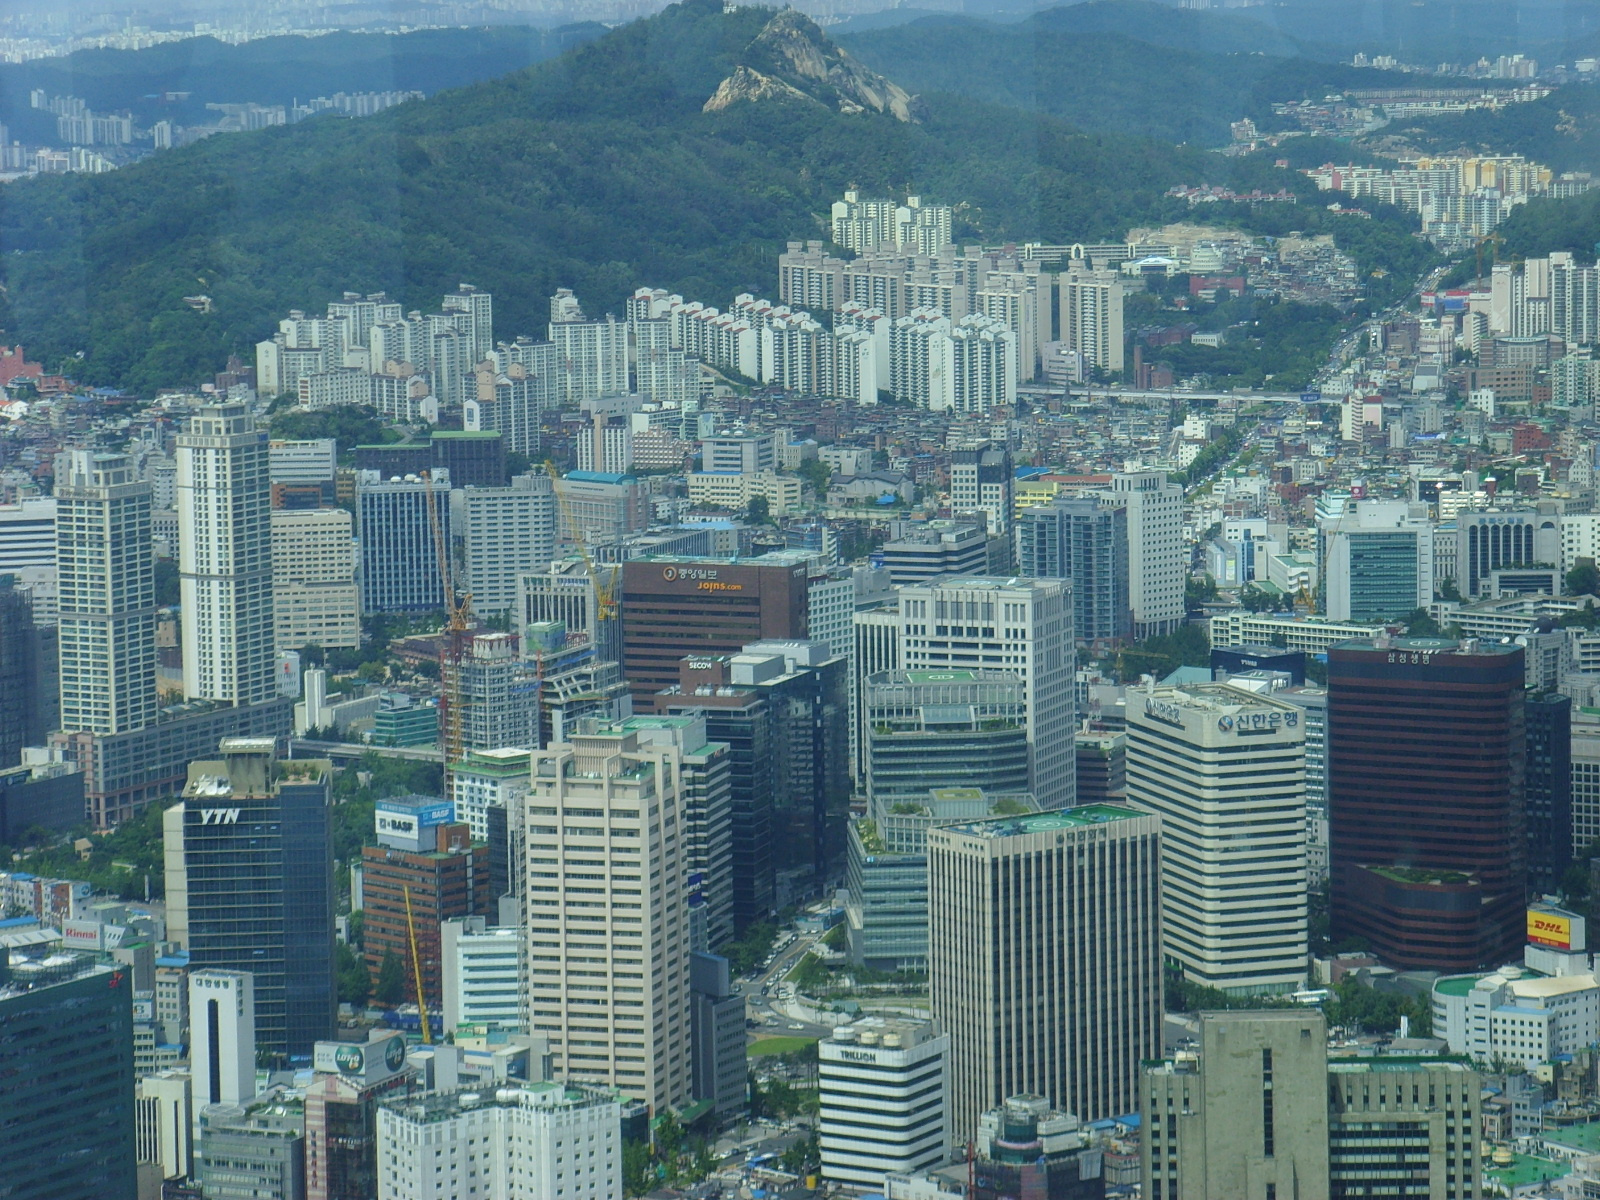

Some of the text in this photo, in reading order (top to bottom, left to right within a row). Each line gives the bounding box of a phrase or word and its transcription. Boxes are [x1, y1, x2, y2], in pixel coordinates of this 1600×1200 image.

[678, 568, 717, 580] 중앙일보
[1388, 652, 1430, 665] 삼성생명
[688, 661, 712, 670] SECOM
[1236, 711, 1298, 730] 신한은행
[200, 808, 241, 825] YTN
[431, 808, 450, 819] BASF
[391, 819, 413, 832] BASF
[65, 928, 97, 939] Rinnai
[1534, 920, 1563, 934] DHL
[840, 1050, 876, 1063] TRILLION
